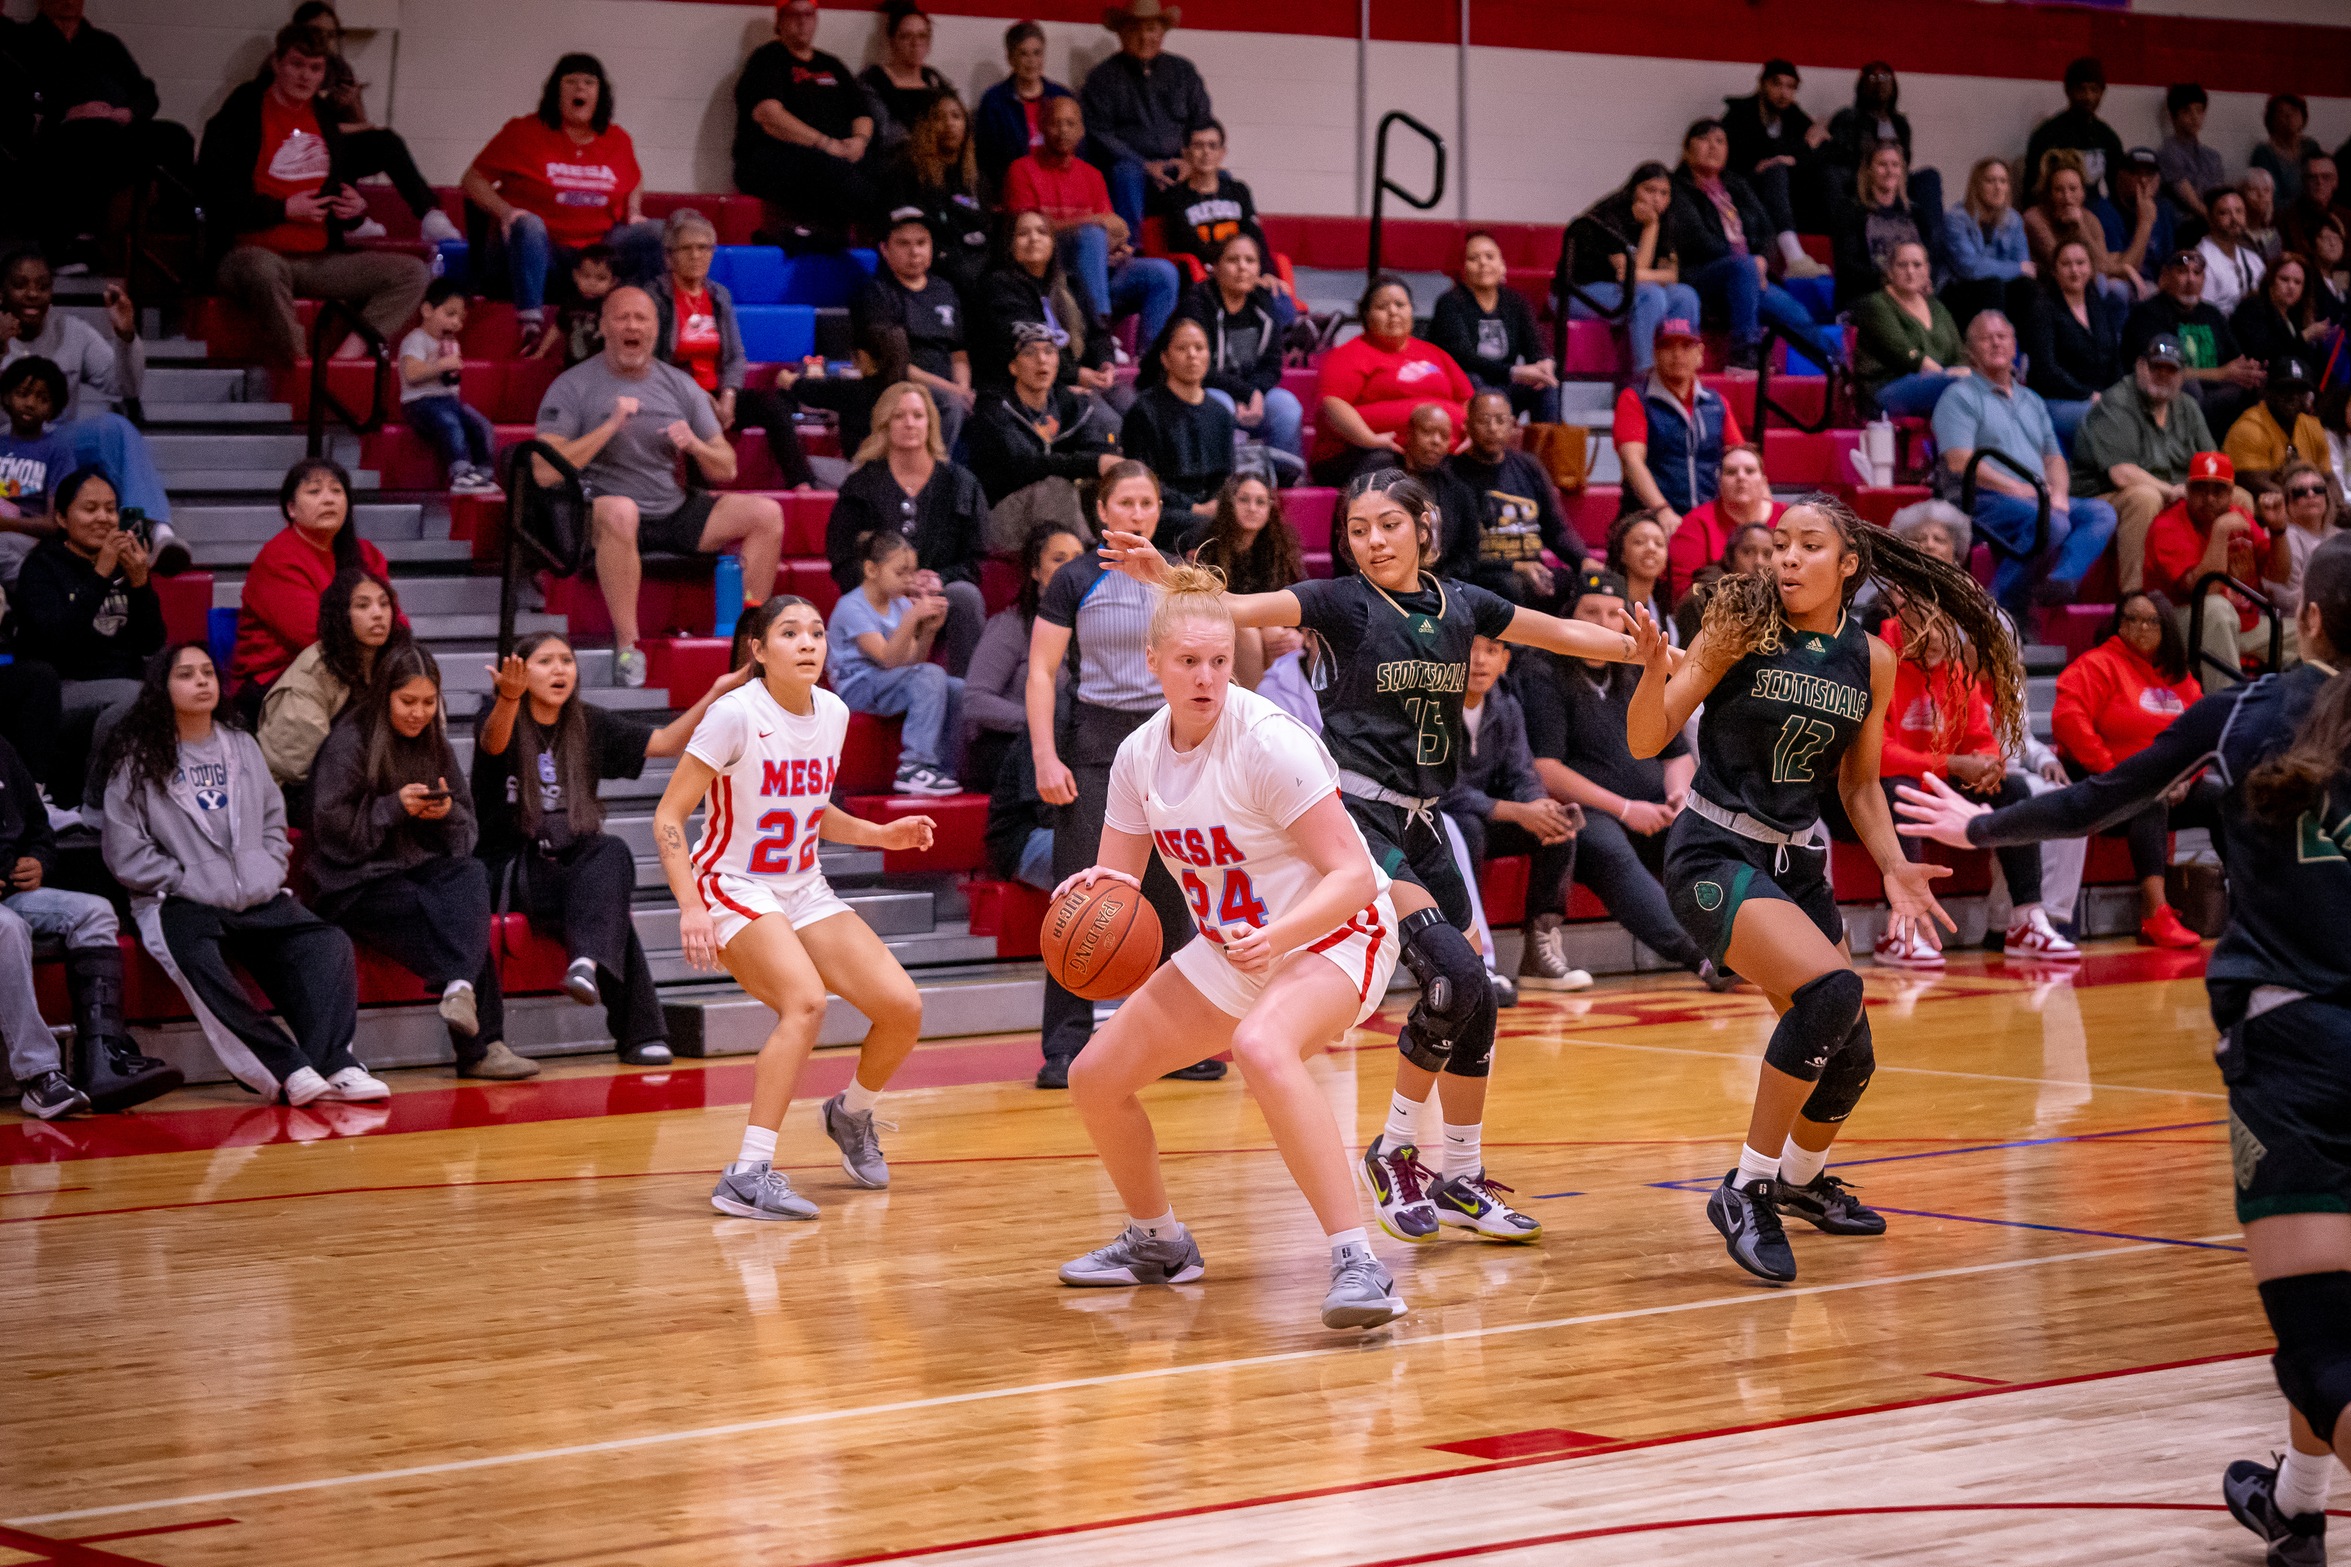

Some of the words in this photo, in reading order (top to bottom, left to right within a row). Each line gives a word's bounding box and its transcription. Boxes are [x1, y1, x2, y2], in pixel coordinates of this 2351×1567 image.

[1751, 669, 1868, 723] SCOTTSDALE
[189, 763, 227, 787] COUG
[1772, 714, 1836, 783] 12
[746, 805, 828, 875] 22
[1069, 894, 1125, 975] SPALDING
[1181, 867, 1269, 944] 24
